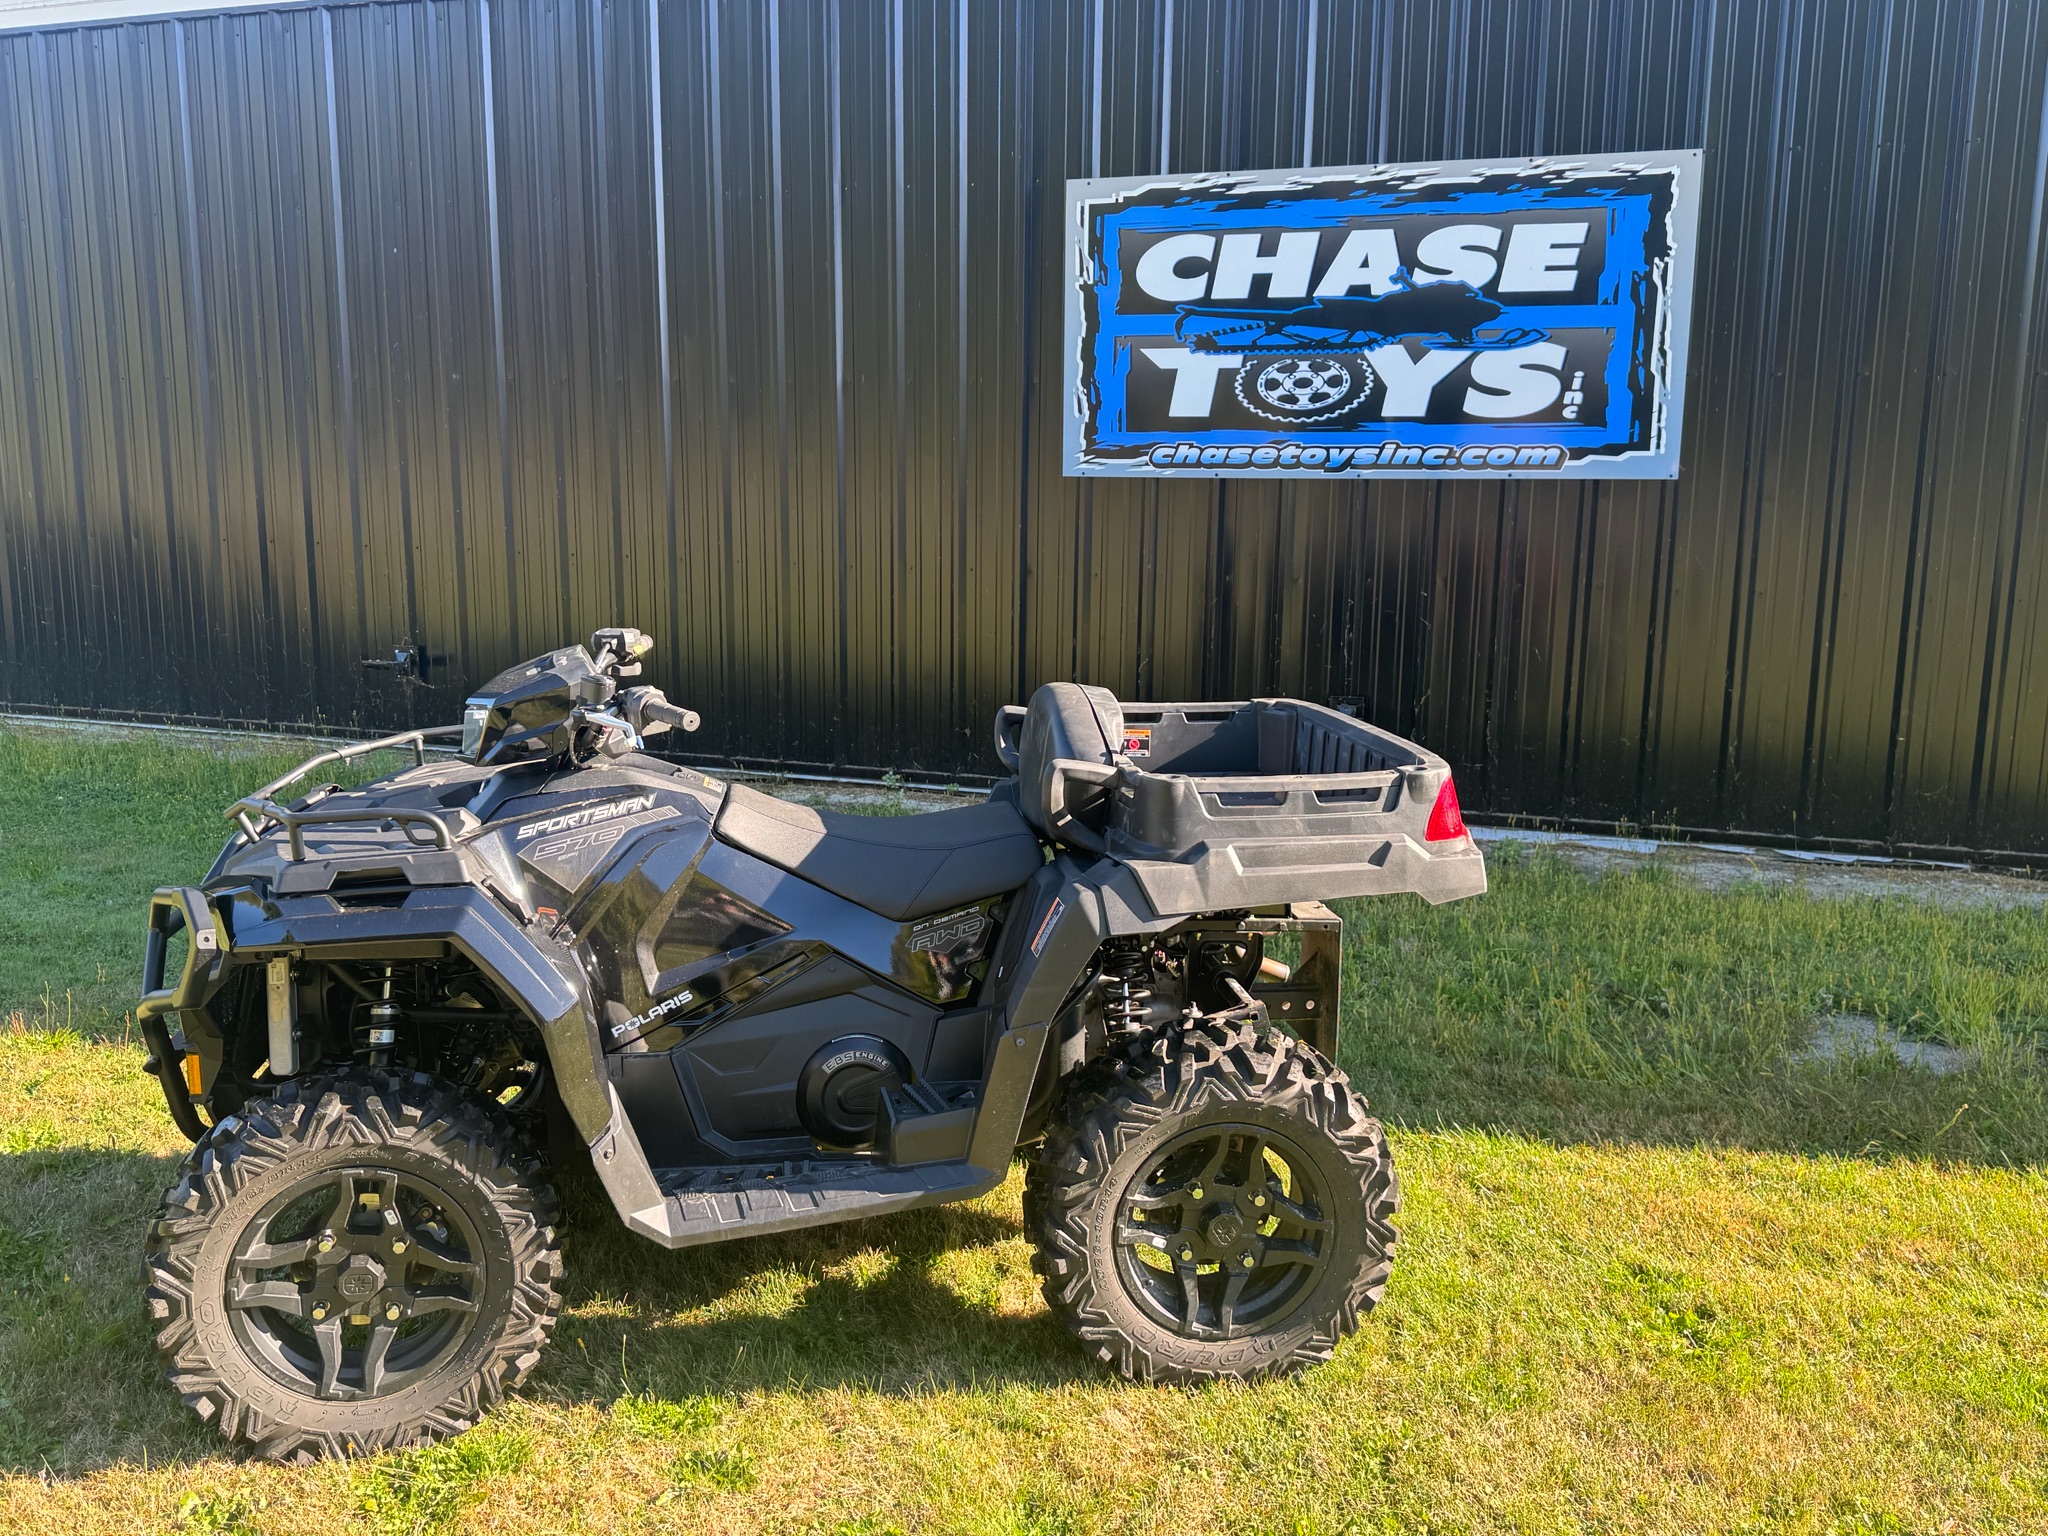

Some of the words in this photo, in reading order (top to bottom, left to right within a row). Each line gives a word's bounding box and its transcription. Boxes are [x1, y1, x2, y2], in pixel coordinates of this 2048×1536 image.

[1136, 222, 1590, 300] CHASE
[1139, 343, 1568, 421] TOYS
[1562, 371, 1584, 419] inc
[1151, 442, 1563, 472] chasetoysinc.com
[516, 793, 657, 840] SPORTSMAN
[533, 825, 625, 860] 570
[911, 915, 985, 953] AWD
[933, 905, 980, 925] DEMAND
[610, 989, 694, 1038] POLARIS
[825, 1052, 853, 1071] EBS
[855, 1051, 888, 1067] ENGINE
